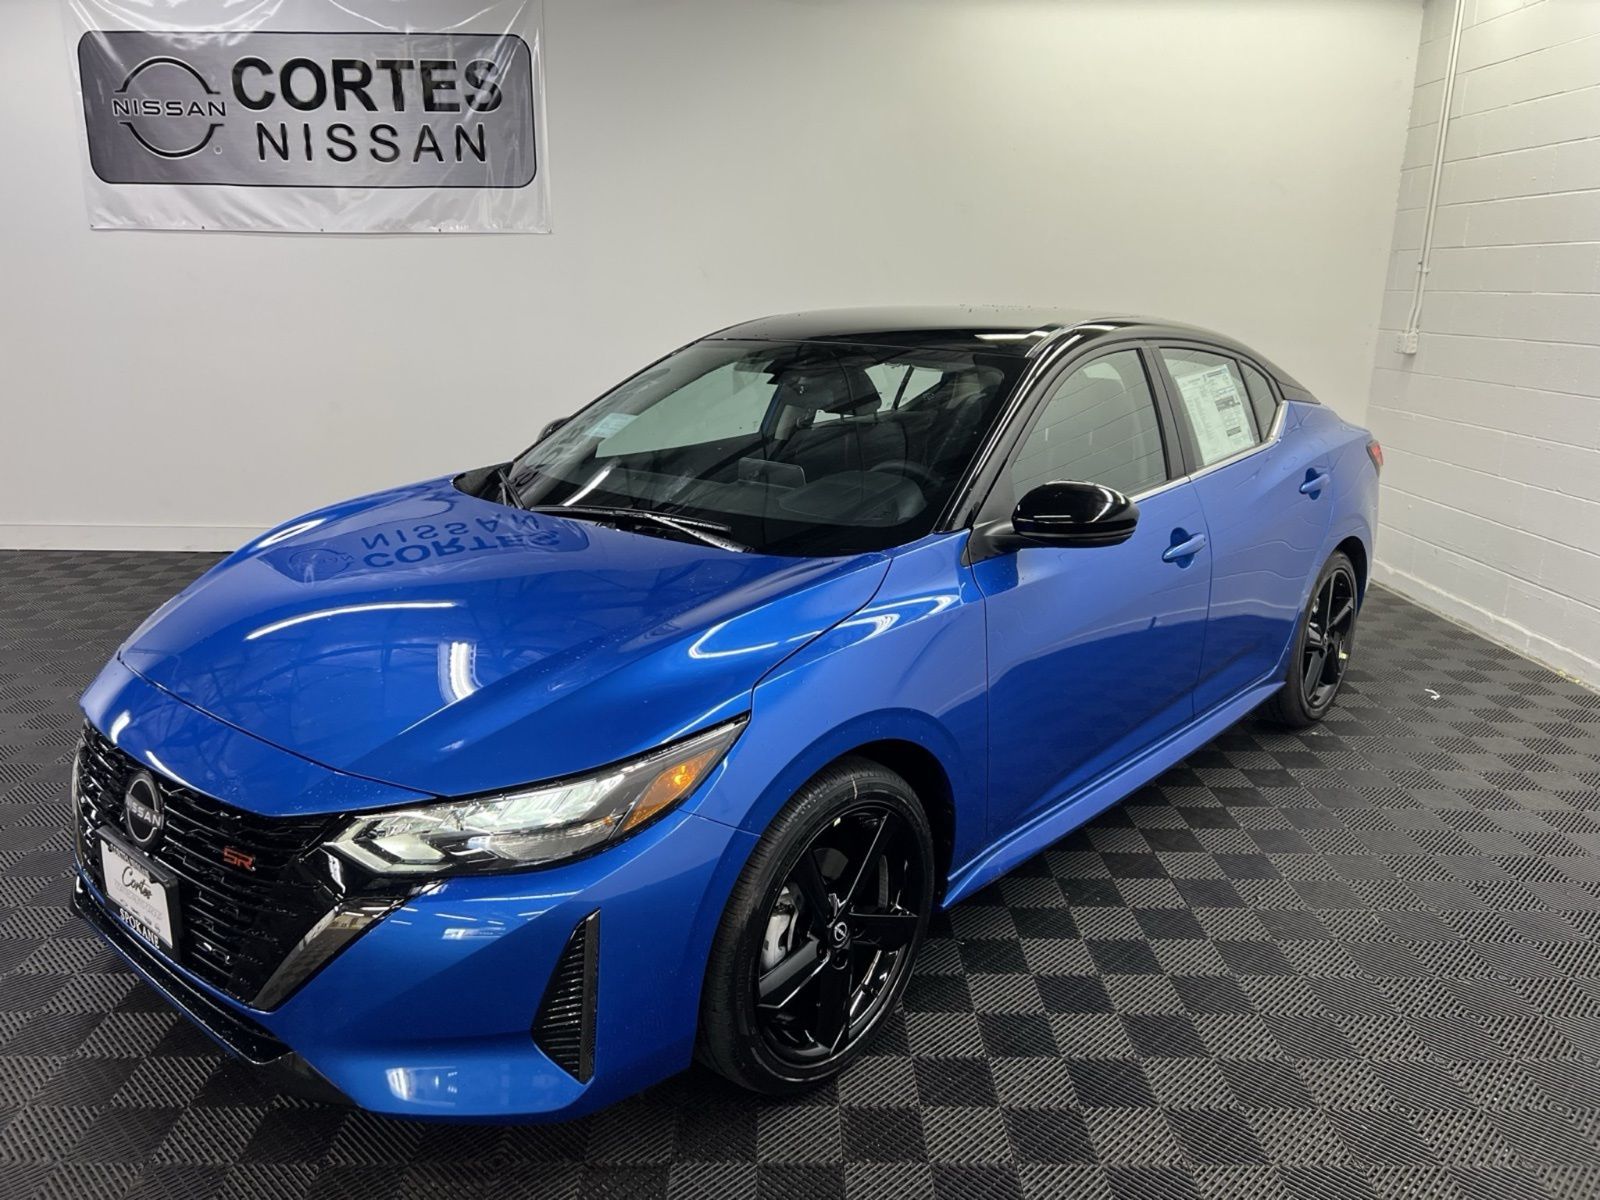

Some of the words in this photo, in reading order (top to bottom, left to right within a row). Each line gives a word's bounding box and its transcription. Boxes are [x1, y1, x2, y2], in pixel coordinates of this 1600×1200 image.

[231, 57, 502, 112] CORTES
[113, 100, 226, 117] NISSAN
[256, 122, 487, 163] NISSAN
[223, 845, 256, 872] SR
[119, 907, 161, 949] SPOKANE
